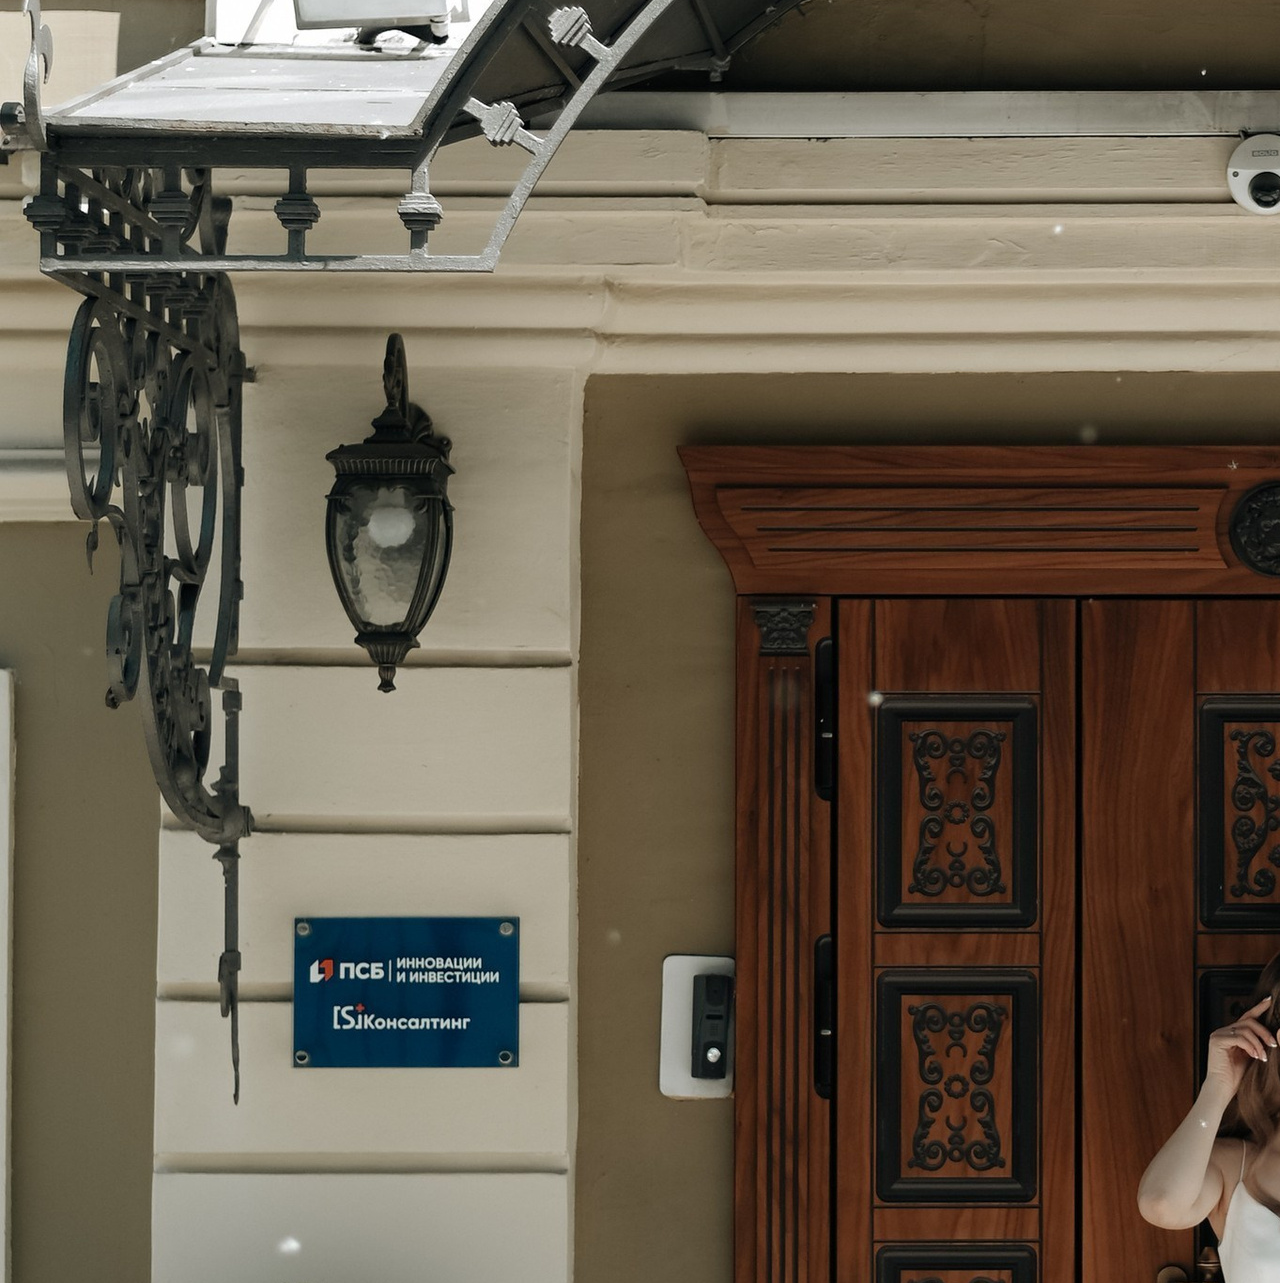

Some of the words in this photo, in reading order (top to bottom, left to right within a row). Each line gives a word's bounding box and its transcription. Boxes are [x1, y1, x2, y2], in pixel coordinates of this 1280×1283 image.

[339, 962, 385, 980] ПСБ
[396, 957, 482, 971] ИННОВАЦИИ
[396, 971, 406, 983] И
[409, 971, 500, 984] ИНВЕСТИЦИИ
